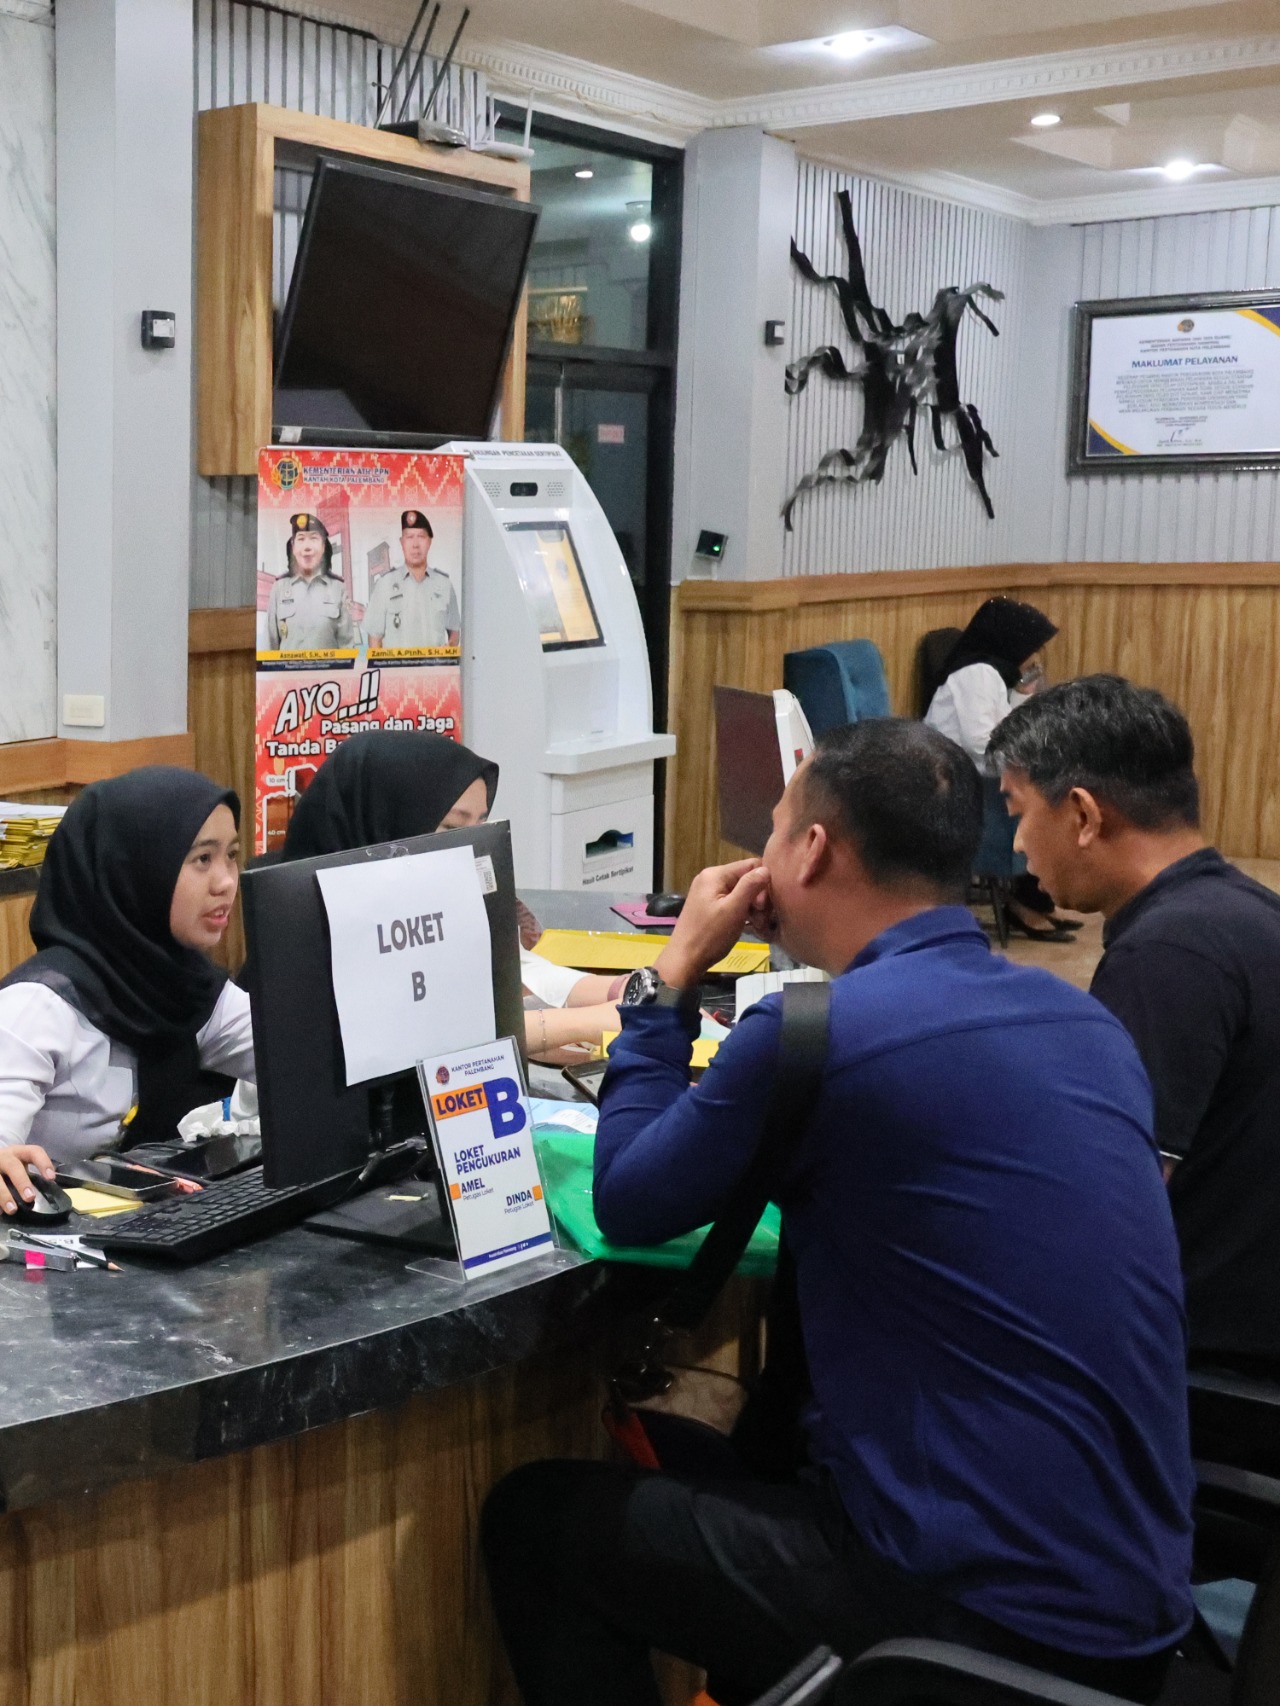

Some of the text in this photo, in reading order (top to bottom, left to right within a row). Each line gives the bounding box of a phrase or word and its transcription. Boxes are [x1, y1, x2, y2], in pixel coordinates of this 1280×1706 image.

[1131, 355, 1238, 369] MAKLUMAT PELAYANAN
[303, 467, 355, 475] KEMENTERIAN
[383, 717, 414, 732] dan
[417, 715, 454, 735] Jaga
[266, 739, 320, 757] Tanda
[376, 911, 445, 955] LOKET
[411, 970, 427, 1002] B
[451, 1054, 505, 1073] KANTOR PERTANAHAN
[464, 1063, 495, 1076] PALEMBANG
[435, 1076, 527, 1140] LOKET B
[453, 1144, 485, 1164] LOKET
[455, 1146, 521, 1176] PENGUKURAN
[461, 1177, 486, 1194] AMEL
[505, 1189, 533, 1207] DINDA
